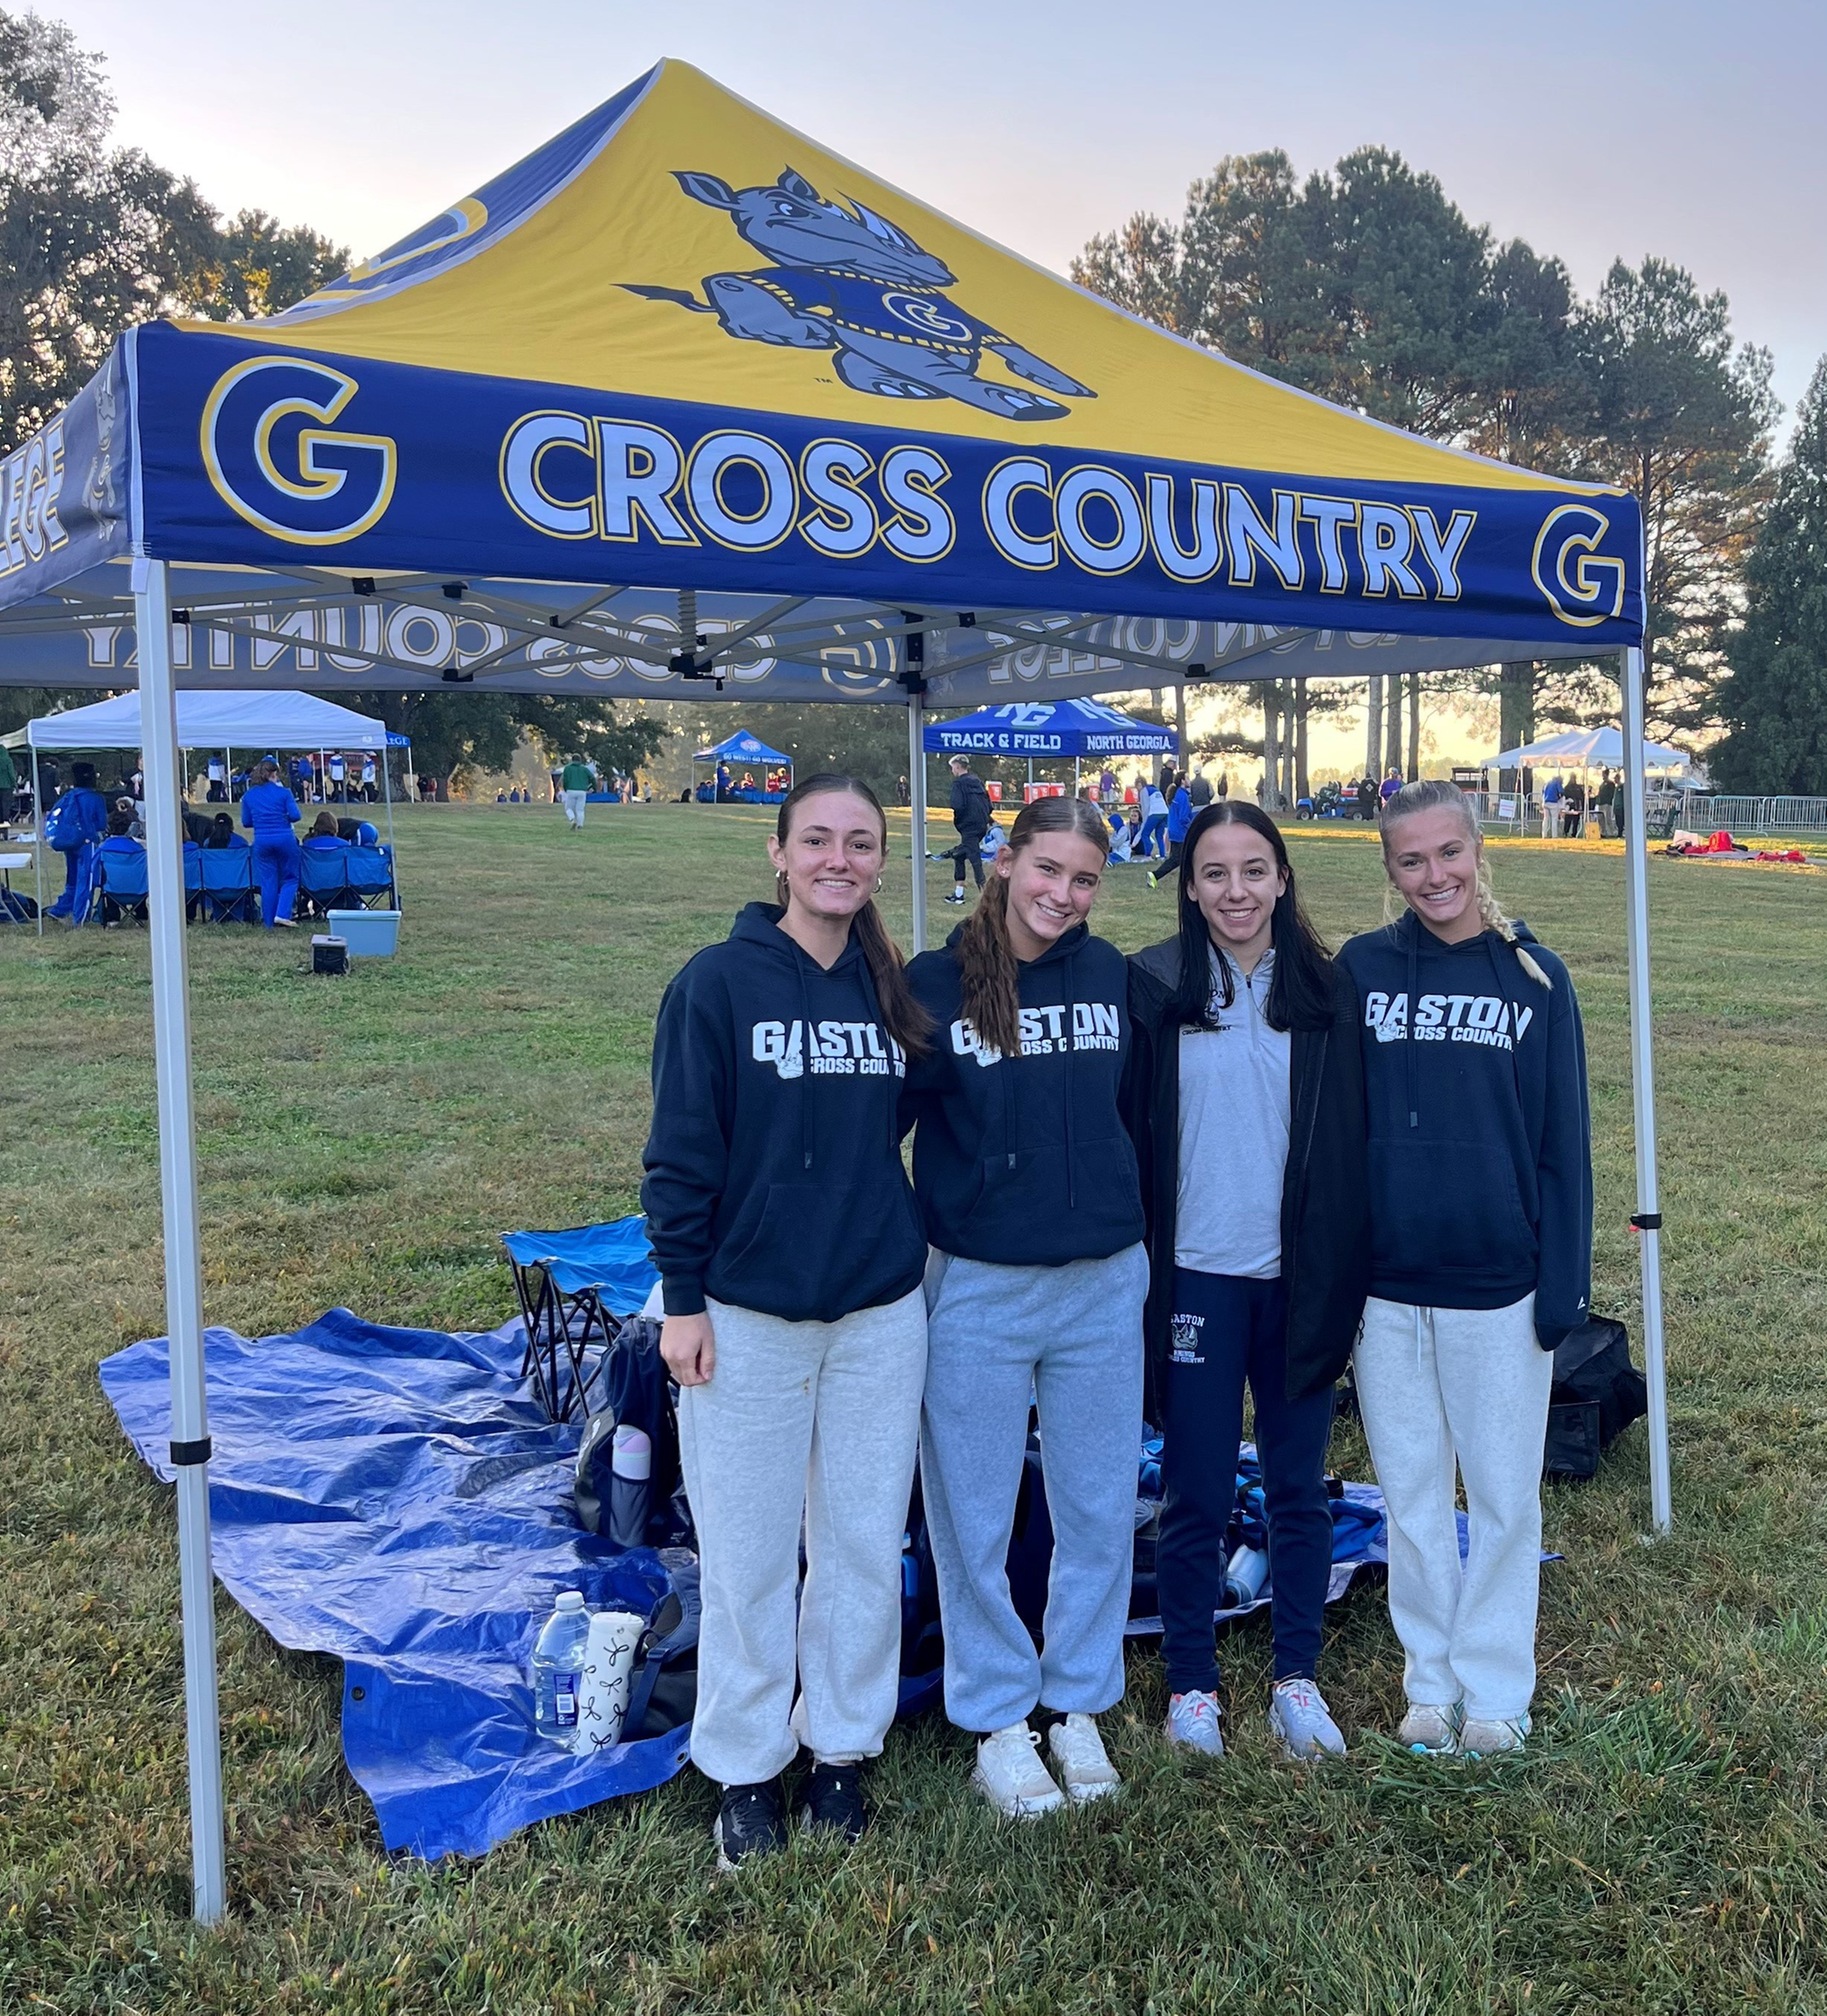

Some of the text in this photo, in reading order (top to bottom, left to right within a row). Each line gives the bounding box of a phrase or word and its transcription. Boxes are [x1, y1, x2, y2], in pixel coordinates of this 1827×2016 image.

[200, 355, 397, 545] G
[499, 409, 1478, 602] CROSS COUNTRY
[1531, 503, 1625, 628] G
[940, 732, 1062, 750] TRACK & FIELD
[1086, 735, 1124, 750] NORTH
[950, 1003, 1120, 1056] GSTON
[1365, 991, 1534, 1044] GASTON
[1009, 1039, 1053, 1057] OSS
[1451, 1026, 1514, 1053] COUNTR
[811, 1057, 906, 1079] ROSS COUTR
